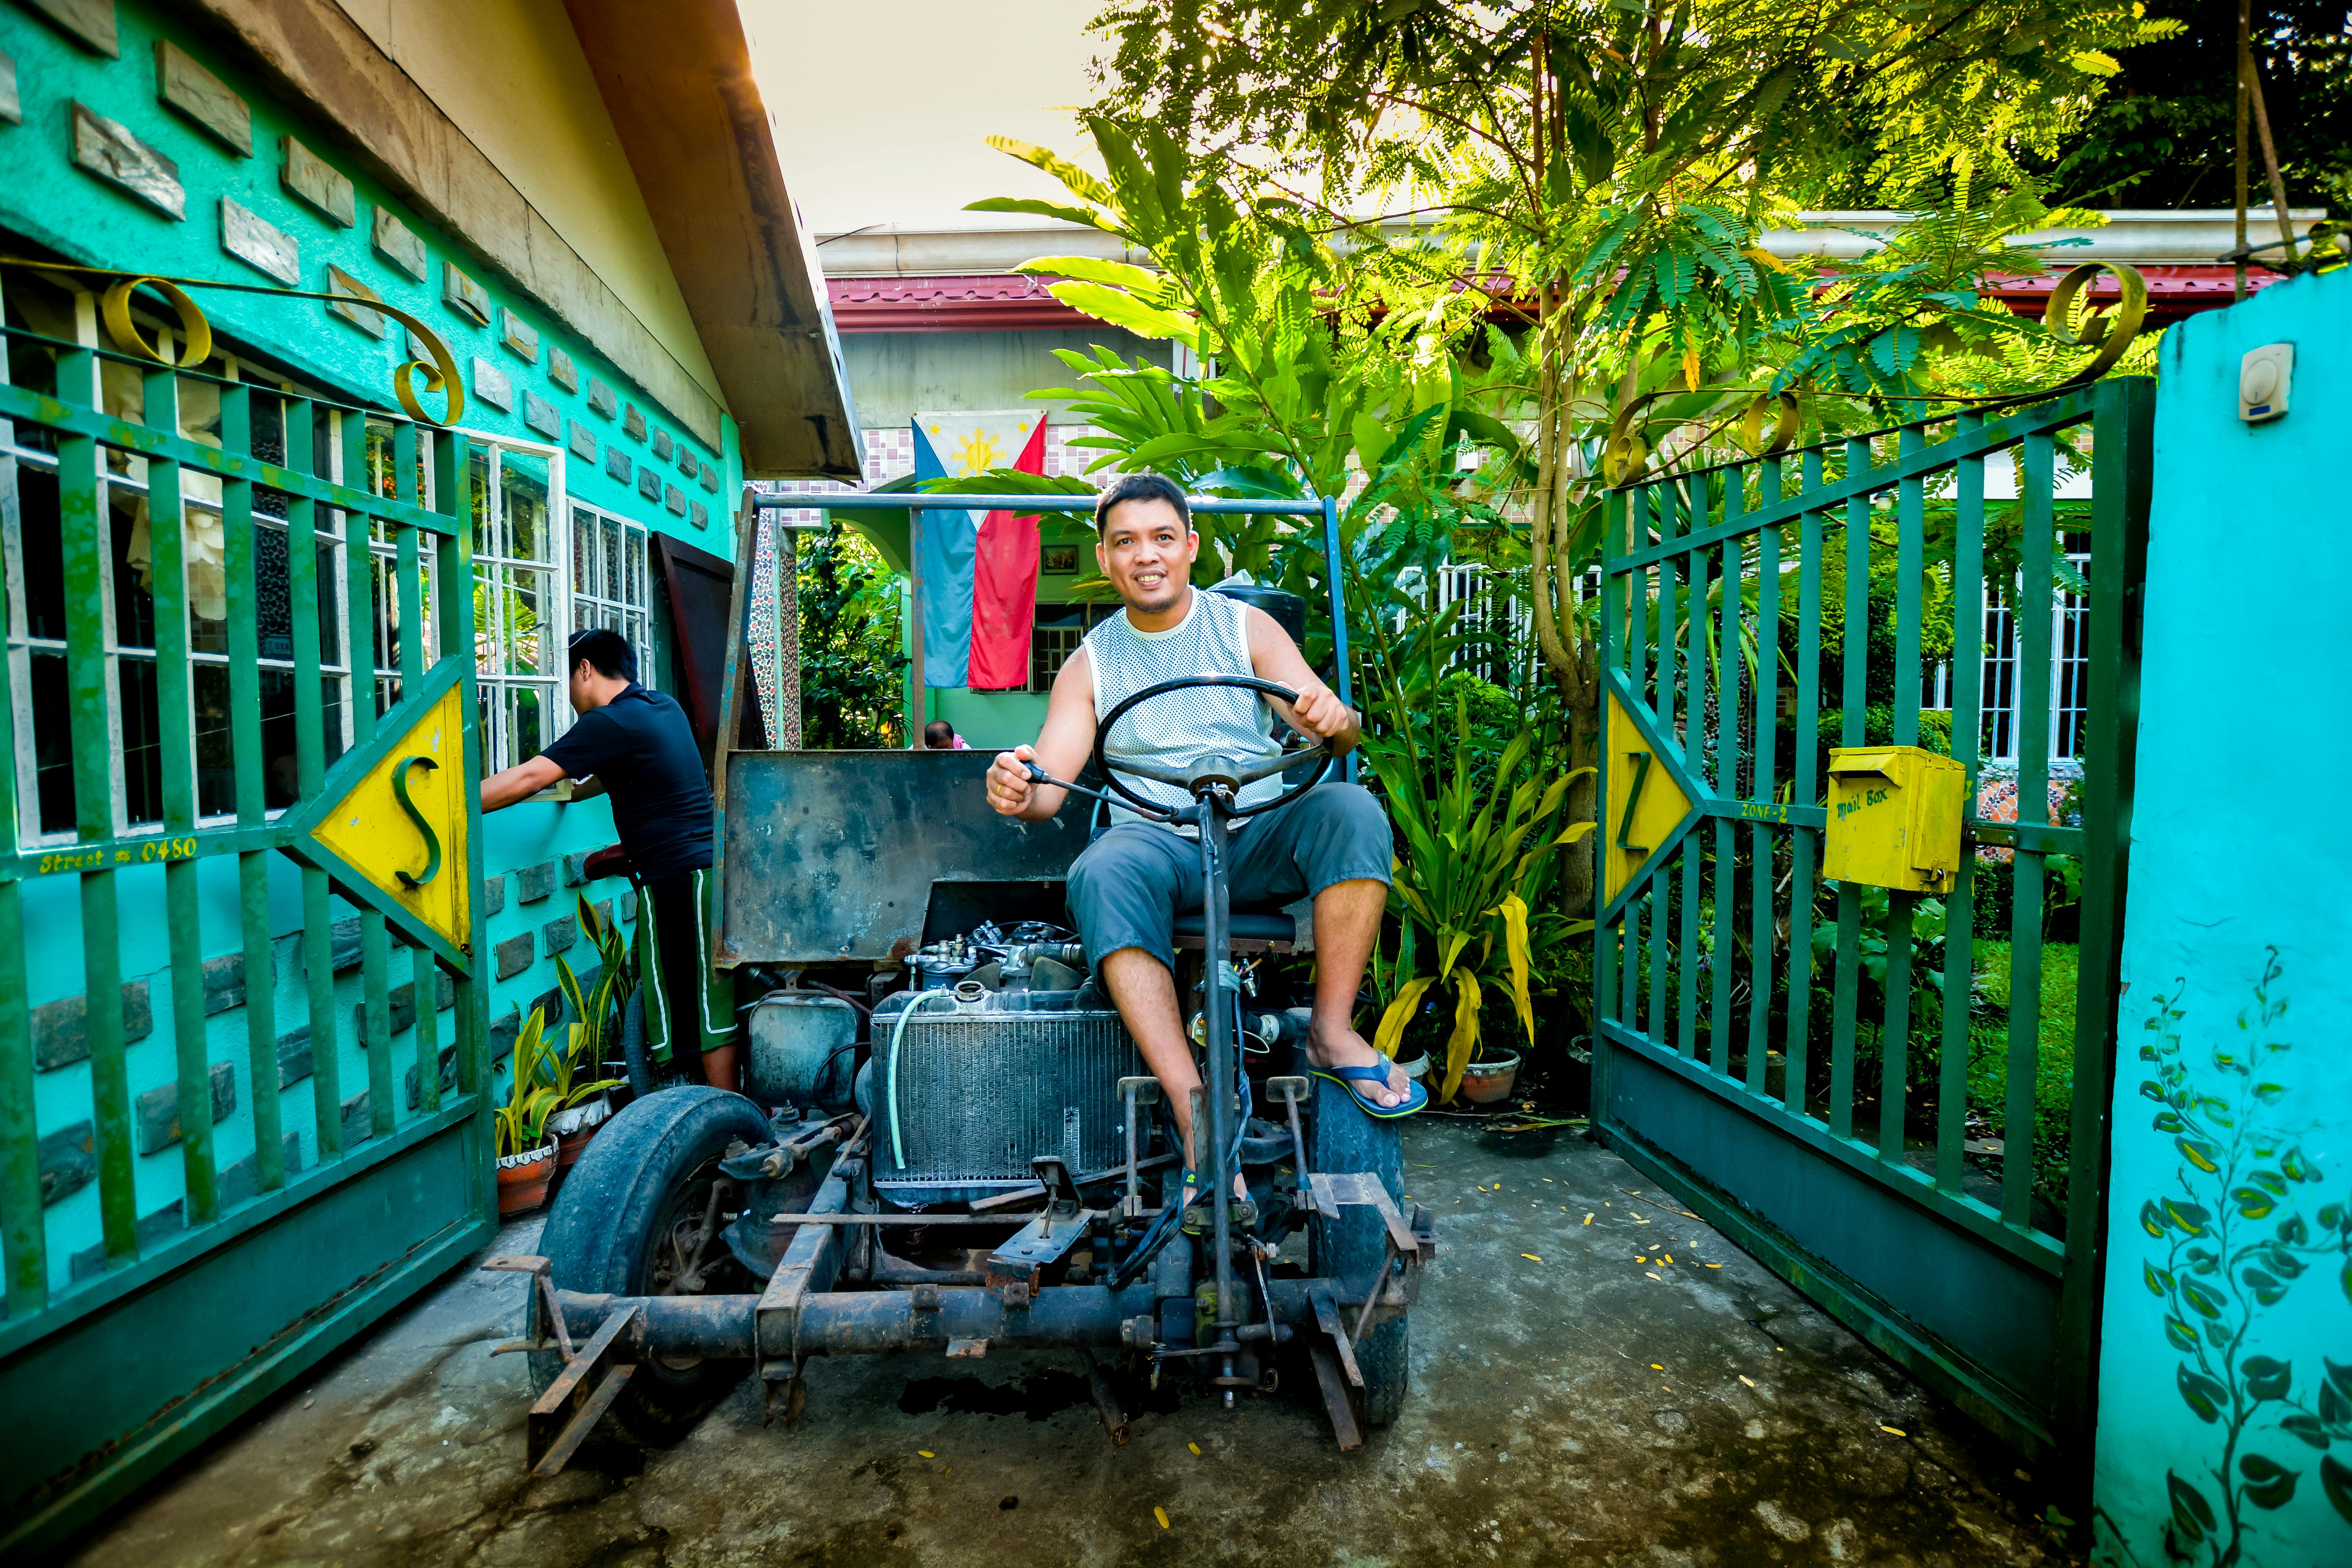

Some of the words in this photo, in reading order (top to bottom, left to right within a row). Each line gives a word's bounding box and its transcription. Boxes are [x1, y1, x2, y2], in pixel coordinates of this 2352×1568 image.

[40, 850, 103, 873] Street
[141, 837, 196, 862] 0480
[392, 756, 441, 884] S
